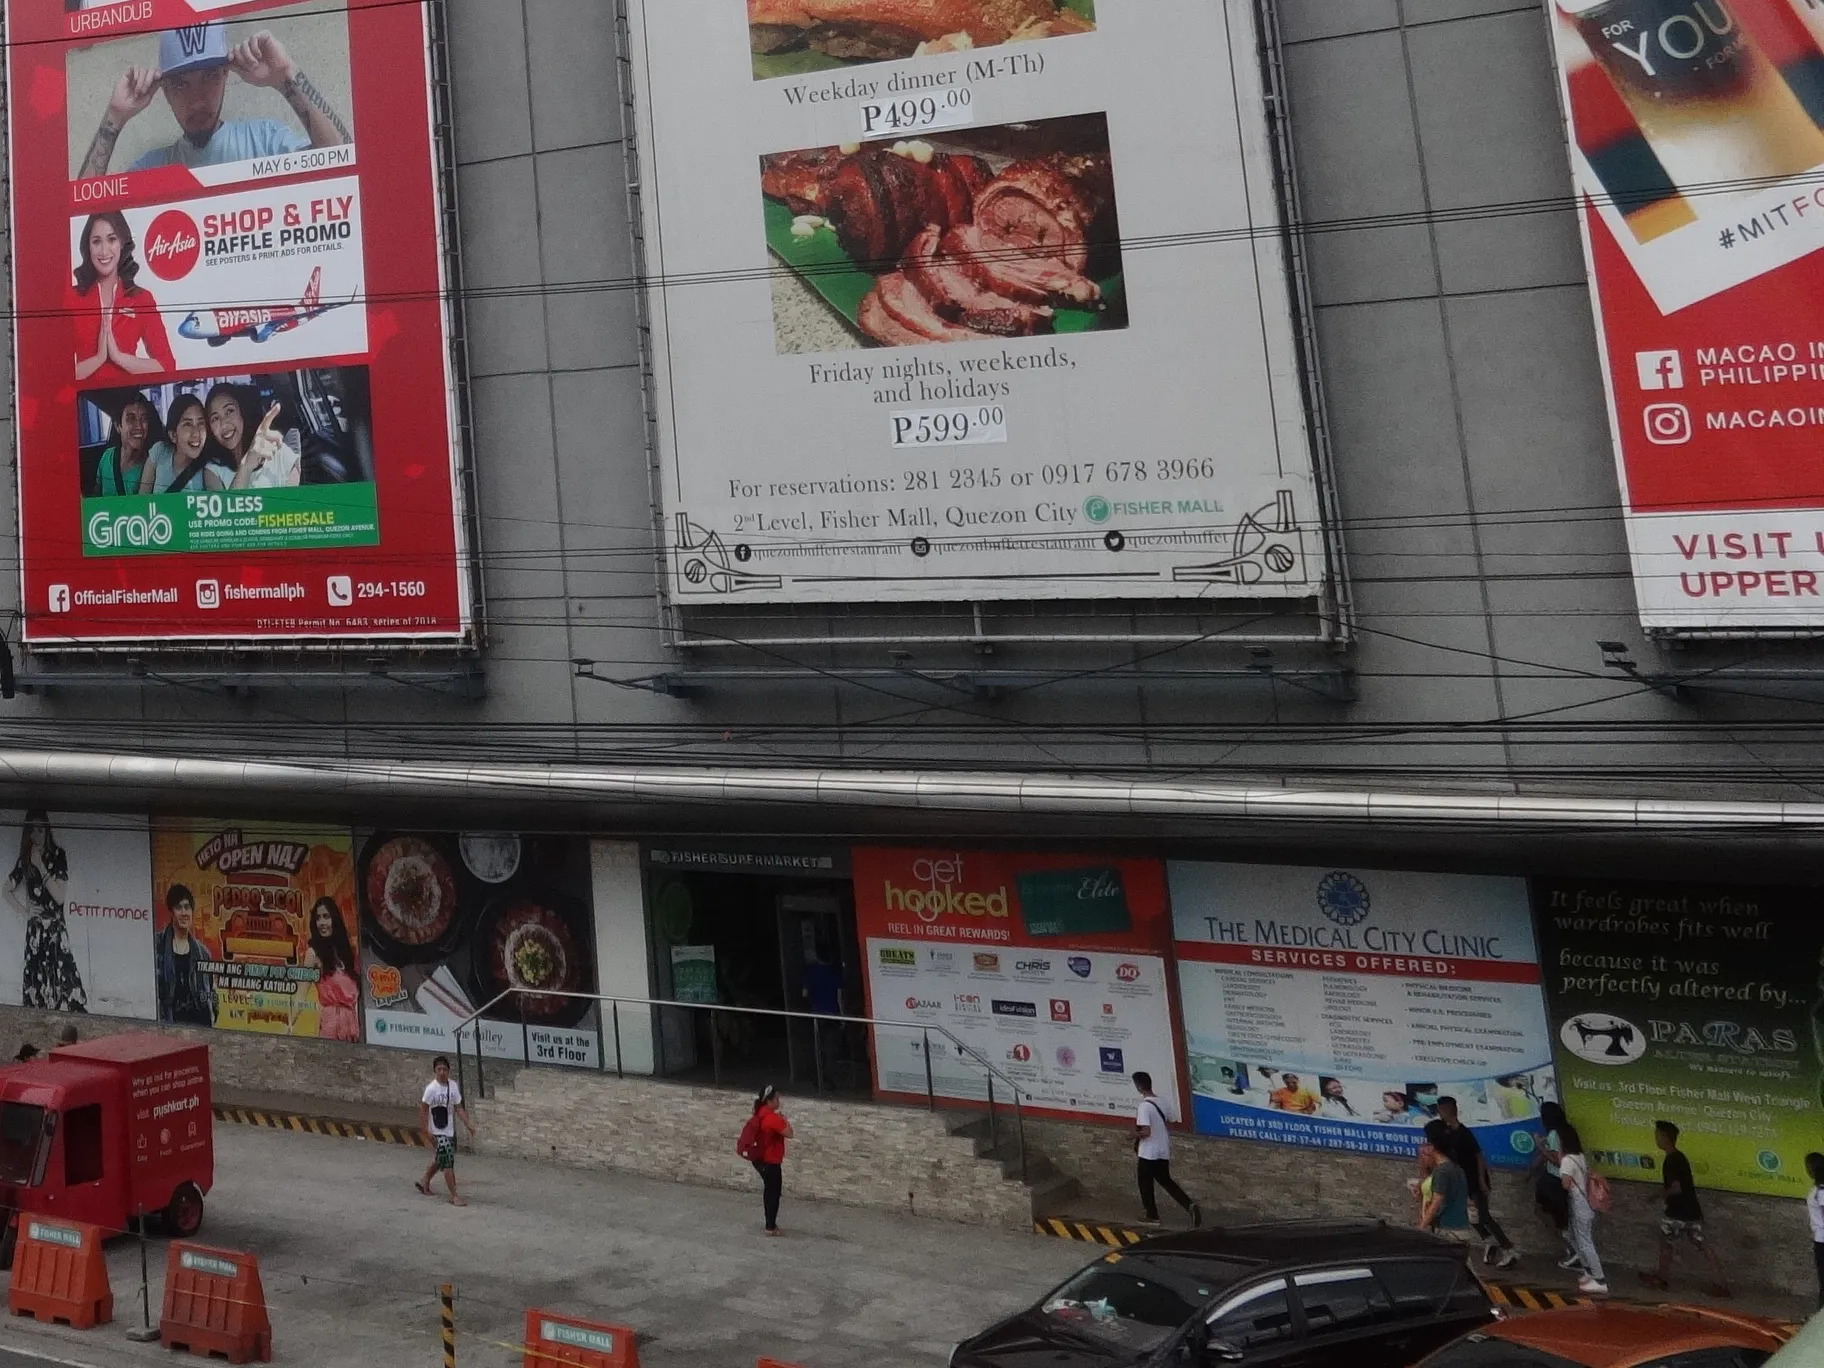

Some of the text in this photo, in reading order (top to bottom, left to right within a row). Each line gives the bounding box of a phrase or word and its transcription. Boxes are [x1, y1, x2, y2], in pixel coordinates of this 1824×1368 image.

[69, 2, 153, 33] URBANDUB
[1602, 19, 1634, 38] FOR
[783, 52, 1045, 106] Weekday dinner (M-Th)
[73, 178, 129, 202] LOONIE
[203, 195, 353, 238] SHOP & FLY
[147, 230, 197, 262] AirAsia
[204, 222, 351, 256] RAFFLE PROMO
[1696, 343, 1796, 365] MACAO
[808, 348, 1078, 387] Friday nights, weekends,
[873, 377, 1010, 403] and holidays
[729, 458, 1214, 498] For reservations: 281 2345 or 0917 678 3966
[227, 496, 263, 513] LESS
[757, 502, 1077, 532] Level, Fisher Mall, Quezon City
[1113, 499, 1224, 515] FISHER MALL
[89, 502, 173, 549] Grab
[189, 512, 334, 528] USE PROMO CODE: FISHERSALE
[1672, 531, 1792, 561] VISIT
[74, 587, 178, 606] OfficialFisherMall
[224, 583, 305, 602] fishermallph
[357, 581, 426, 598] 294-1560
[1680, 570, 1819, 598] UPPER
[219, 844, 300, 870] OPEN NA!
[913, 854, 964, 883] get
[884, 880, 1009, 922] hooked
[1550, 890, 1760, 916] It feels great when
[888, 922, 1010, 940] REEL IN GREAT REWARDS!
[1204, 916, 1503, 958] THE MEDICAL CITY CLINIC
[1554, 914, 1773, 941] wardrobes fits well
[197, 962, 241, 974] TIKMAN ANG
[1116, 966, 1136, 979] DQ
[1251, 949, 1457, 975] SERVICES OFFERED:
[1559, 949, 1721, 976] because it was
[231, 979, 296, 993] WALANG KATULAD
[1559, 973, 1806, 1009] perfectly altered by...
[389, 1023, 421, 1034] FISHER
[531, 1032, 590, 1047] Visit us at the
[1648, 1020, 1798, 1055] PARAS
[536, 1045, 586, 1062] 3rd Floor
[153, 1093, 199, 1120] pushkart.ph
[1220, 1115, 1266, 1128] LOCATED AT
